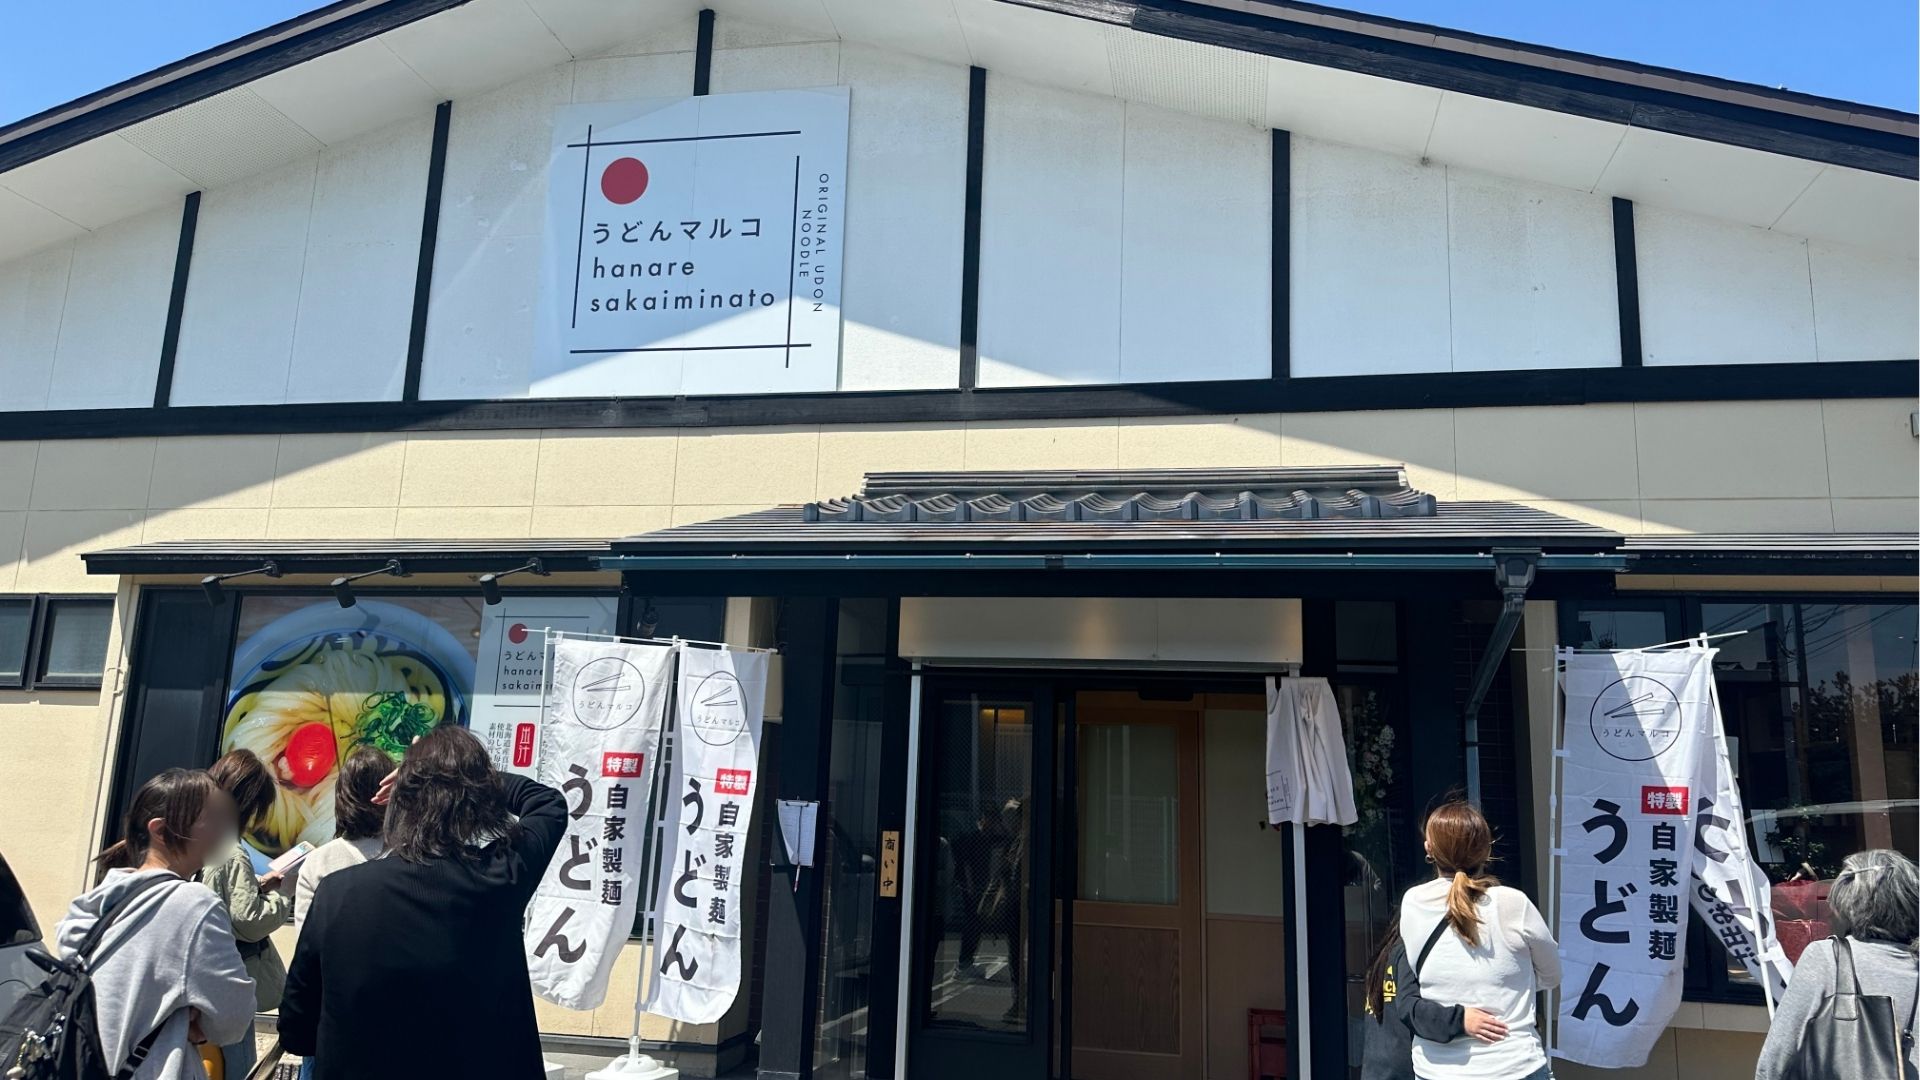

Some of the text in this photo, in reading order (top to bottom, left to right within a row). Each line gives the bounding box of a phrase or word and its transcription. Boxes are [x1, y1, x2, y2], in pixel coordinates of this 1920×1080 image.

[593, 218, 761, 244] うどんマルコ
[799, 209, 812, 277] NOODLE
[813, 173, 829, 312] ORIGINAL UDON
[593, 257, 695, 279] hanare
[590, 288, 775, 312] sakaiminato
[1603, 728, 1669, 738] うどんマルコ
[605, 757, 638, 773] 特製
[719, 773, 748, 791] 特製
[1647, 791, 1685, 811] 特製
[533, 763, 598, 963] うどん
[601, 784, 629, 906] 自家製麺
[708, 801, 740, 924] 自家製麺
[882, 837, 897, 891] 商い中
[660, 777, 707, 981] うどん
[1648, 822, 1679, 961] 自家製麺
[1571, 798, 1639, 1026] うどん
